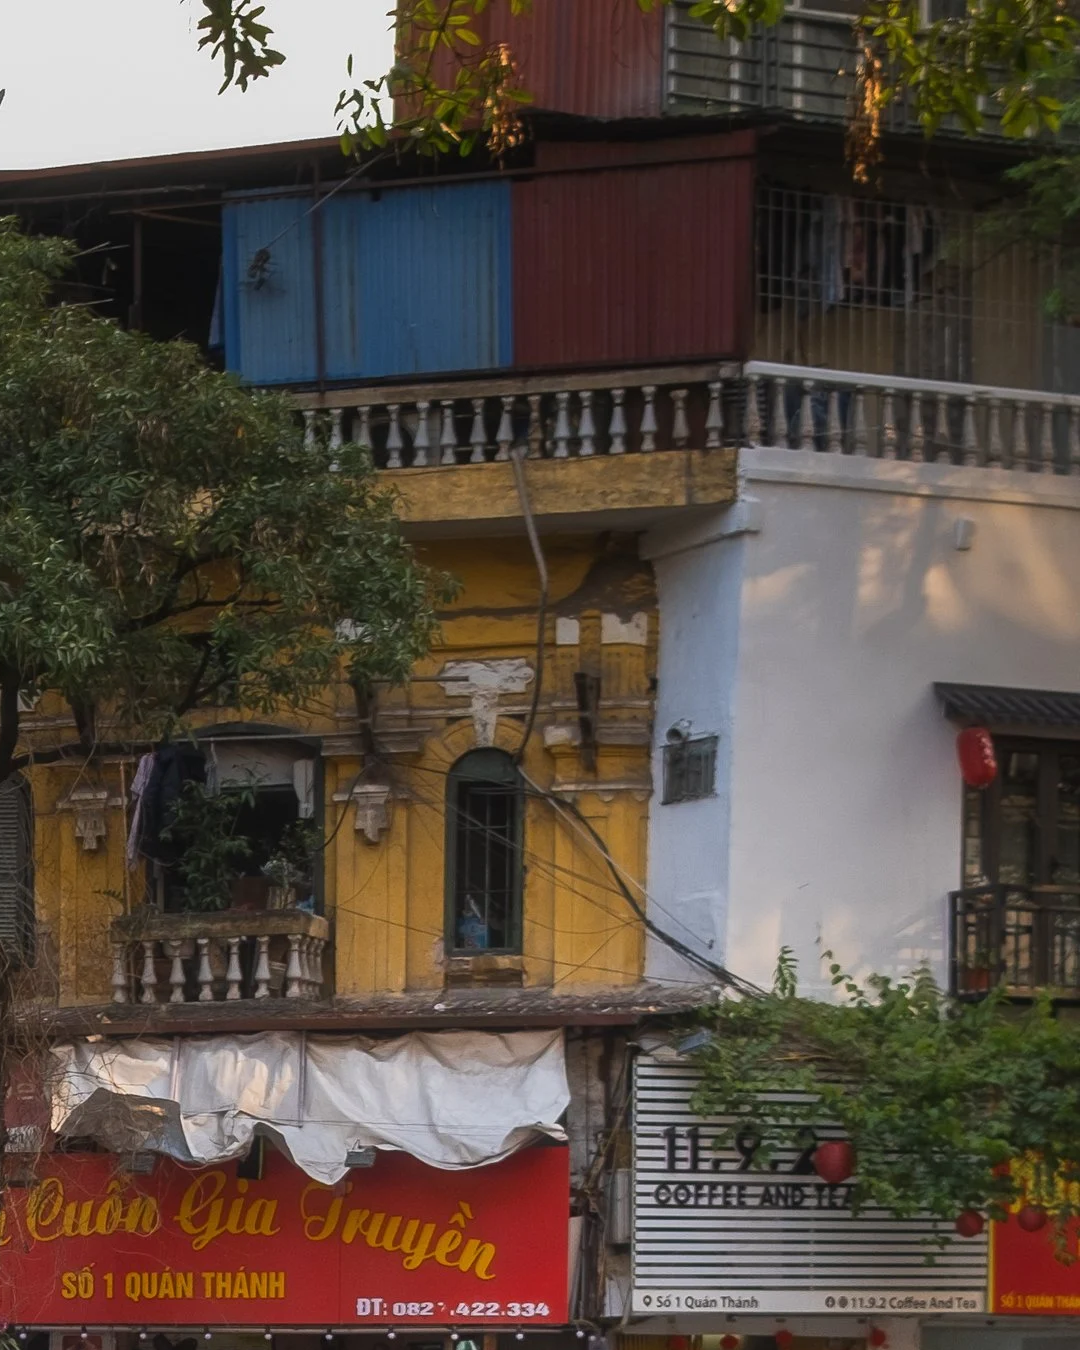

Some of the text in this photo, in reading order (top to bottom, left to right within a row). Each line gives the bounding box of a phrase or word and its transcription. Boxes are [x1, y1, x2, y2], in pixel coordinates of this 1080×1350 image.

[654, 1183, 747, 1207] COFFEE
[759, 1183, 806, 1208] AND
[174, 1172, 281, 1251] Gia
[299, 1181, 497, 1280] Truyền
[61, 1262, 286, 1301] SỐ 1 QUÁN THÁNH
[392, 1302, 550, 1317] 082.422.334
[656, 1294, 672, 1308] Số
[850, 1295, 977, 1310] 11.9.2 Coffee And Tea
